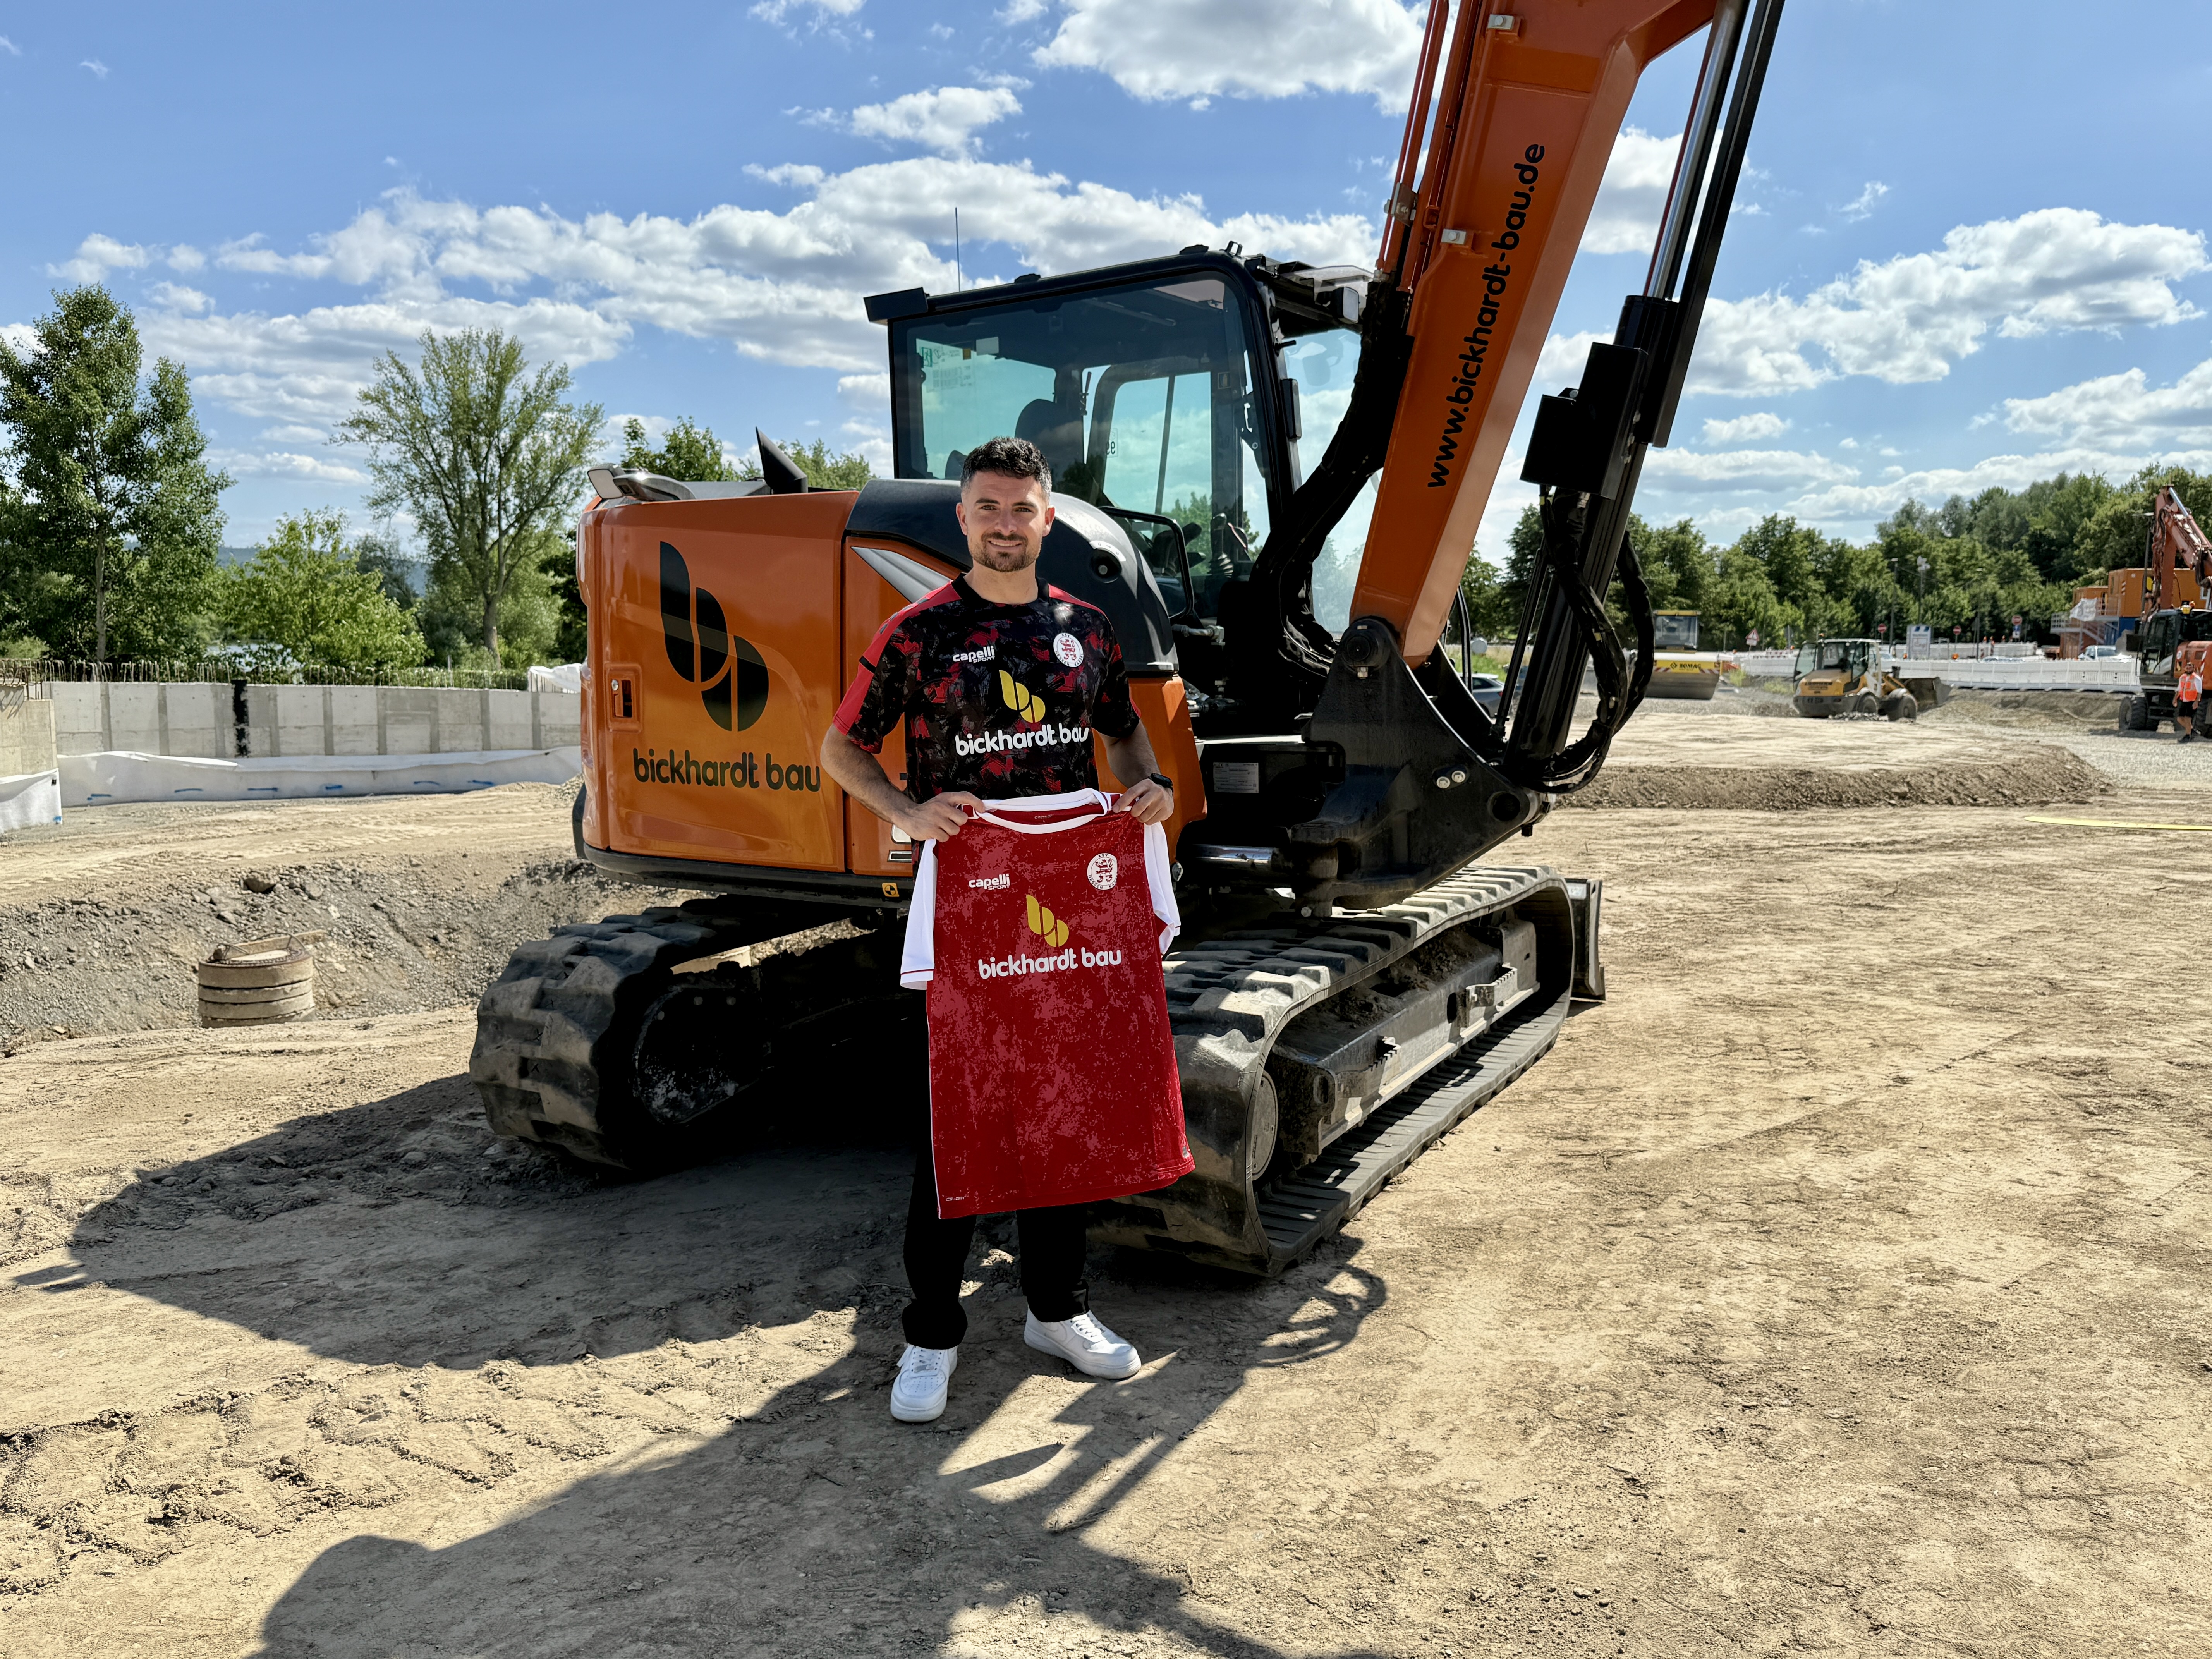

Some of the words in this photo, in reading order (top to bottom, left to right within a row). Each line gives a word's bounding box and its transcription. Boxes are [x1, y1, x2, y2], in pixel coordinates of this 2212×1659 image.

[1427, 143, 1545, 488] www.bickhardt-bau.de
[953, 645, 995, 663] capelli
[955, 724, 1057, 756] bickhardt
[1059, 723, 1089, 744] bau
[633, 747, 759, 788] bickhardt
[766, 752, 820, 792] bau
[968, 873, 1010, 890] capelli
[978, 948, 1078, 979] bickhardt
[1081, 947, 1121, 968] bau
